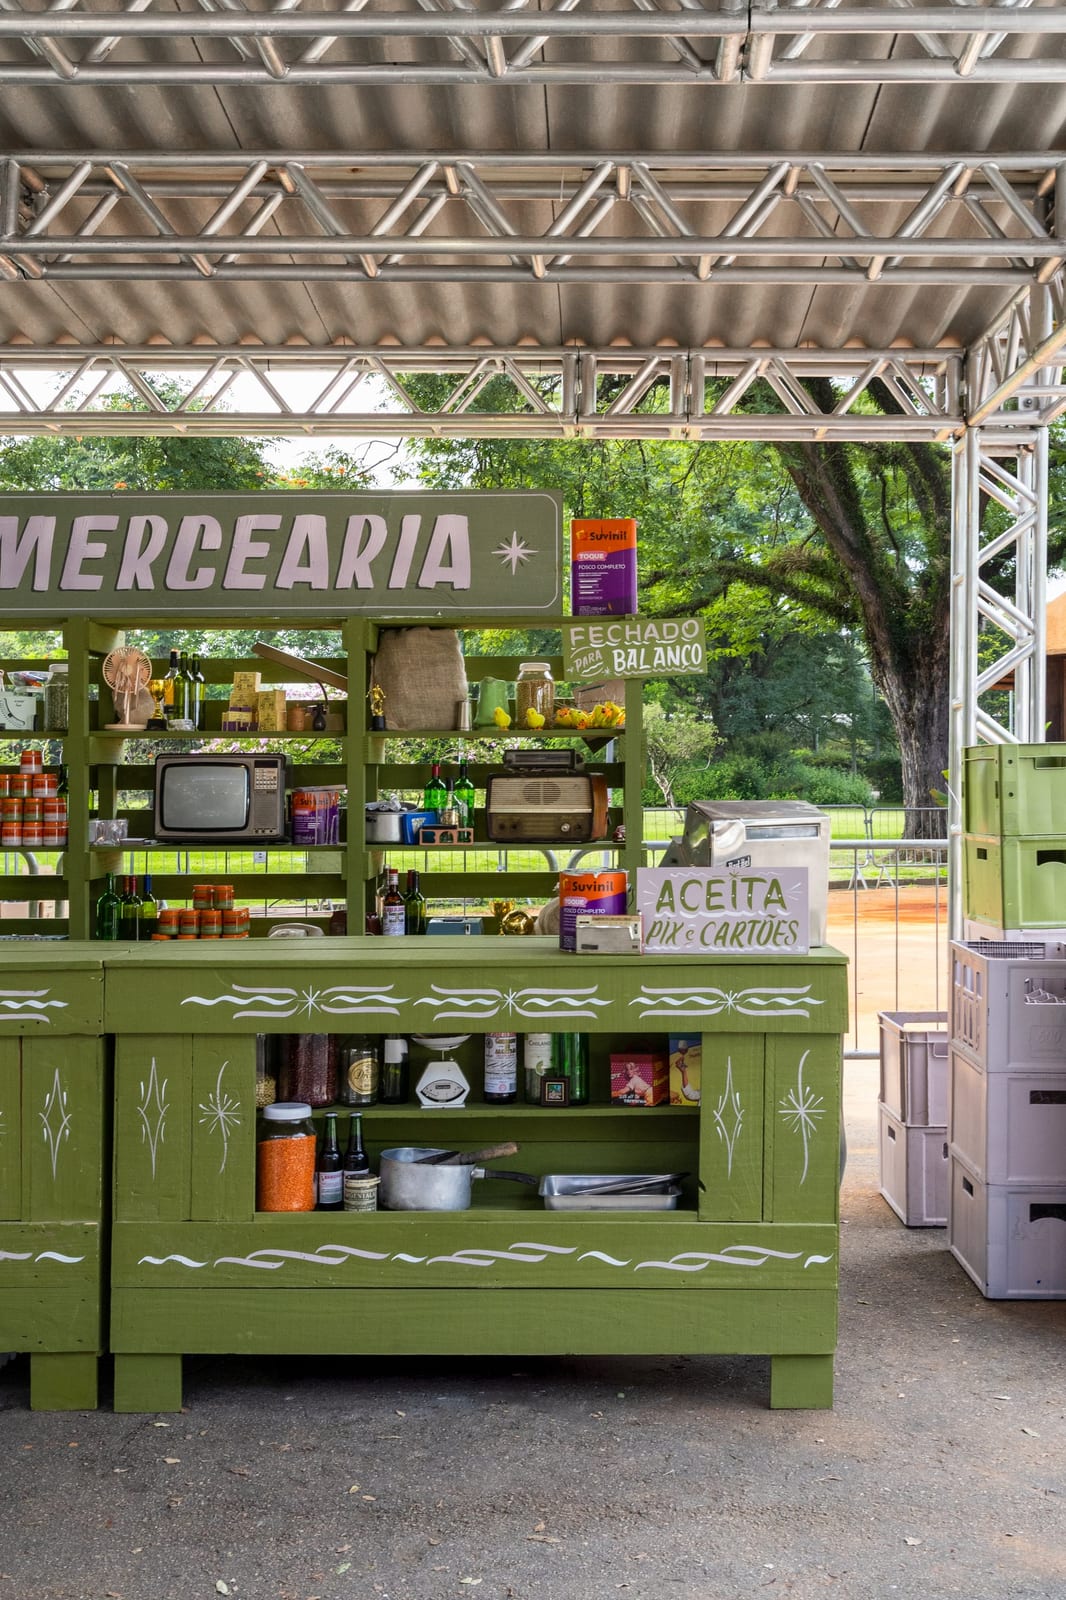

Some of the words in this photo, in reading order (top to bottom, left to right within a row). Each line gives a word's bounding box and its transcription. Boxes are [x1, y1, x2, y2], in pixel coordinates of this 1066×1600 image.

[589, 531, 627, 541] Suvinil
[570, 620, 699, 646] FECHADO
[574, 649, 603, 672] PARA
[611, 643, 702, 673] BALANÇO
[572, 881, 614, 891] Suvinil
[656, 876, 787, 913] ACEITA
[645, 917, 684, 946] PIX
[700, 914, 800, 948] CARTÕES
